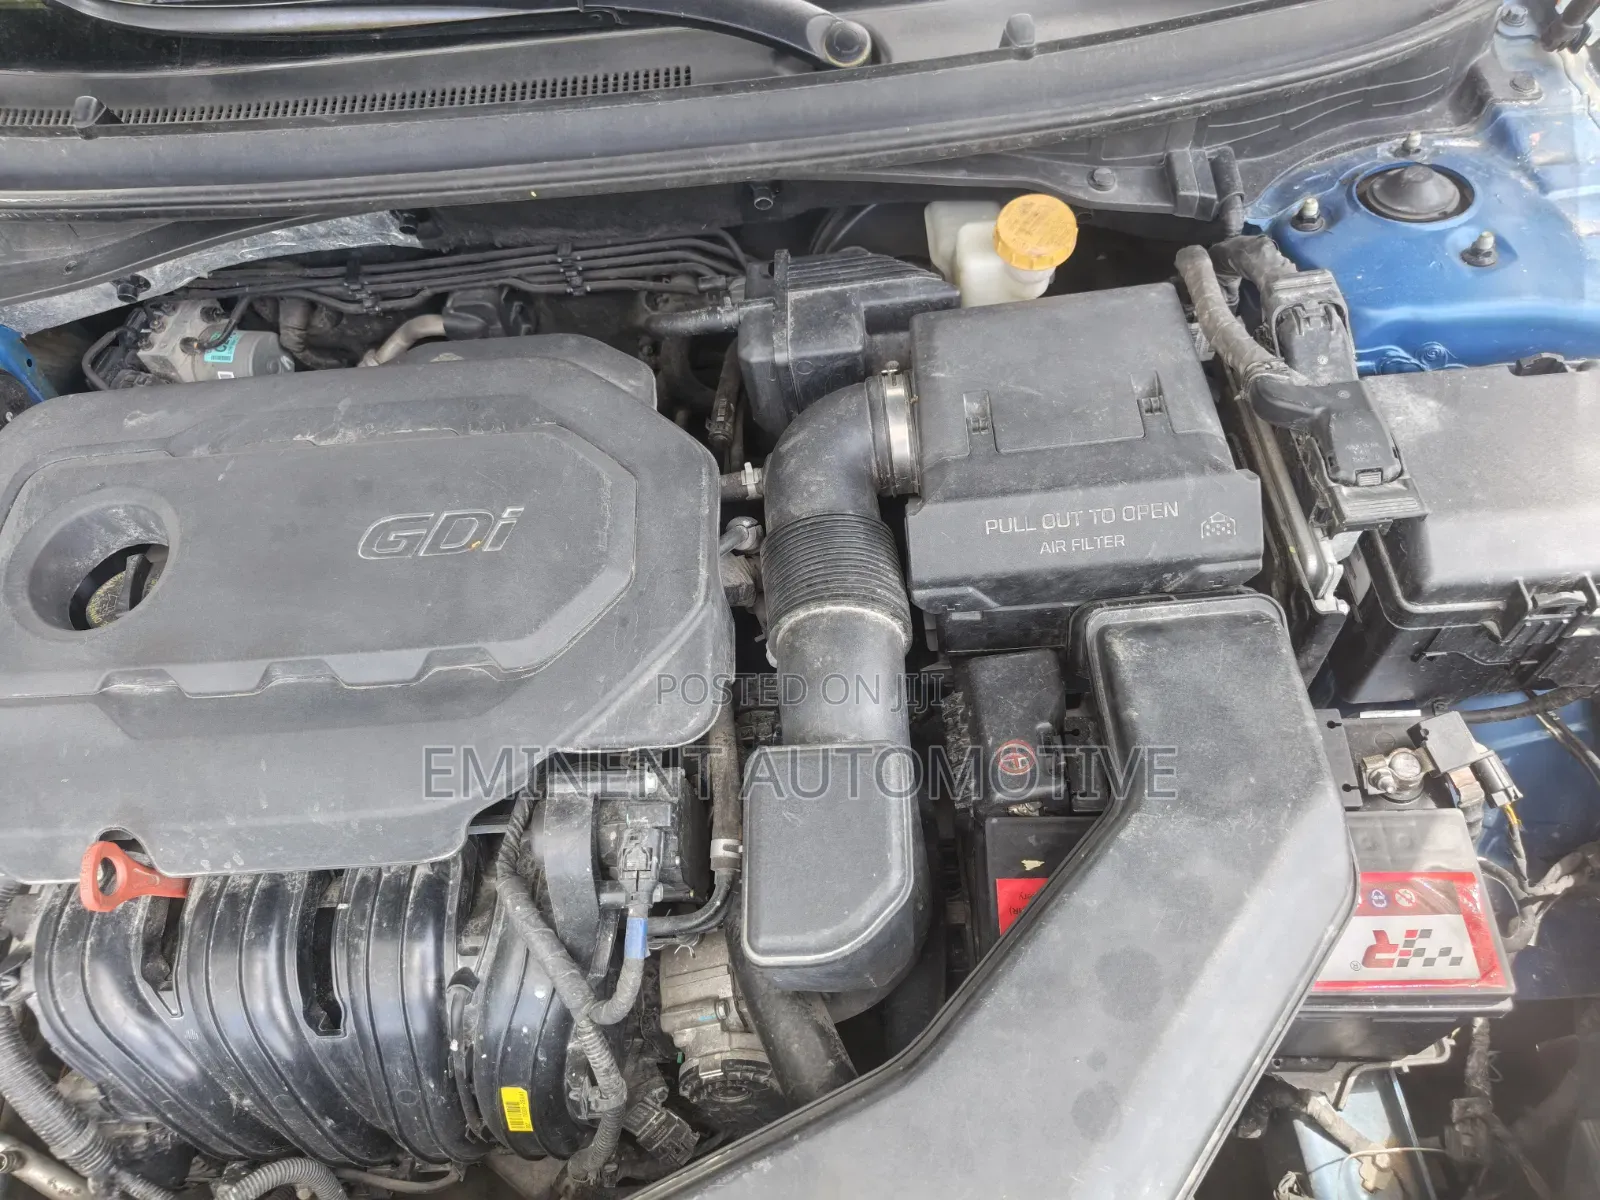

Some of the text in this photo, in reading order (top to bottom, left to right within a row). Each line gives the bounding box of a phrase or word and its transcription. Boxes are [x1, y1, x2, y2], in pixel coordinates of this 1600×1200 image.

[357, 506, 525, 560] GDi
[985, 501, 1180, 535] PULL OUT TO OPEN
[1039, 534, 1126, 554] AIR FILTER
